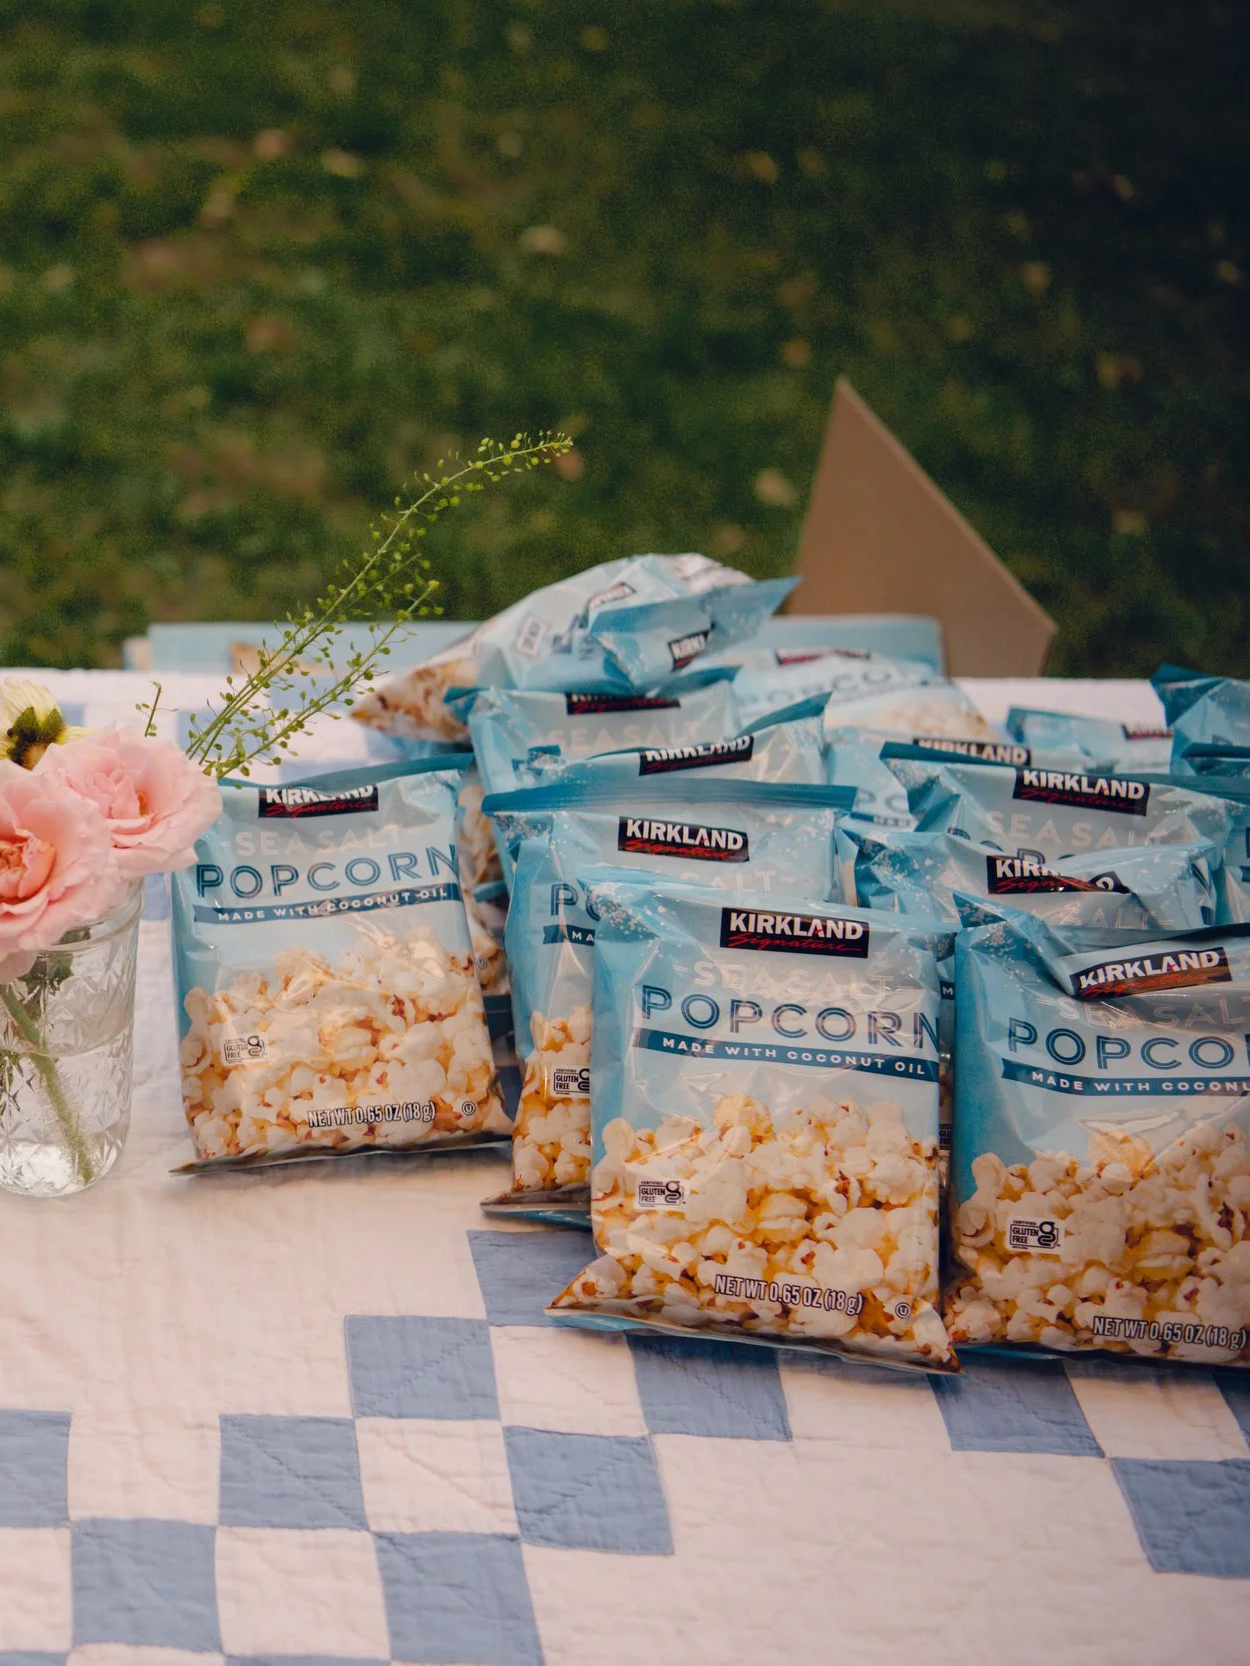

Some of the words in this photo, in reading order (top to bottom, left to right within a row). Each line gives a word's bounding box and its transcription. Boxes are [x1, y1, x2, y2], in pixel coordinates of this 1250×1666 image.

[1023, 769, 1146, 800] KIRKLAND
[236, 830, 310, 856] SEA
[316, 824, 402, 854] SALT
[626, 818, 744, 850] KIRKLAND
[986, 810, 1063, 844] SEA
[196, 844, 456, 900] POPCORN
[217, 909, 266, 922] MADE
[273, 905, 318, 919] WITH
[326, 891, 411, 913] COCONUT
[414, 888, 448, 900] OIL
[727, 931, 862, 952] Signature
[729, 912, 864, 941] KIRKLAND
[694, 961, 773, 993] SEA
[788, 969, 895, 1000] SALT
[1078, 950, 1221, 990] KIRKLAND
[641, 984, 940, 1051] POPCORN
[662, 1037, 715, 1055] MADE
[725, 1045, 777, 1059] WITH
[787, 1050, 887, 1069] COCONUT
[894, 1061, 926, 1076] OIL
[1007, 1016, 1250, 1071] POPCO
[555, 1074, 579, 1083] GLUTEN
[555, 1082, 570, 1090] FREE
[1031, 1070, 1084, 1091] MADE
[1093, 1081, 1150, 1092] WITH
[307, 1109, 333, 1128] NET
[331, 1107, 354, 1126] WT
[355, 1104, 383, 1124] 0.65
[384, 1103, 401, 1123] OZ
[641, 1187, 666, 1196] GLUTEN
[641, 1195, 656, 1203] FREE
[1011, 1226, 1039, 1237] GLUTEN
[1012, 1235, 1029, 1244] FREE
[714, 1274, 744, 1298] NET
[743, 1277, 769, 1301] WT
[768, 1281, 801, 1306] 0.65
[802, 1285, 824, 1309] OZ
[1093, 1315, 1122, 1336] NET
[1122, 1317, 1148, 1339] WT
[1149, 1320, 1183, 1343] 0.65
[1183, 1323, 1206, 1344] OZ
